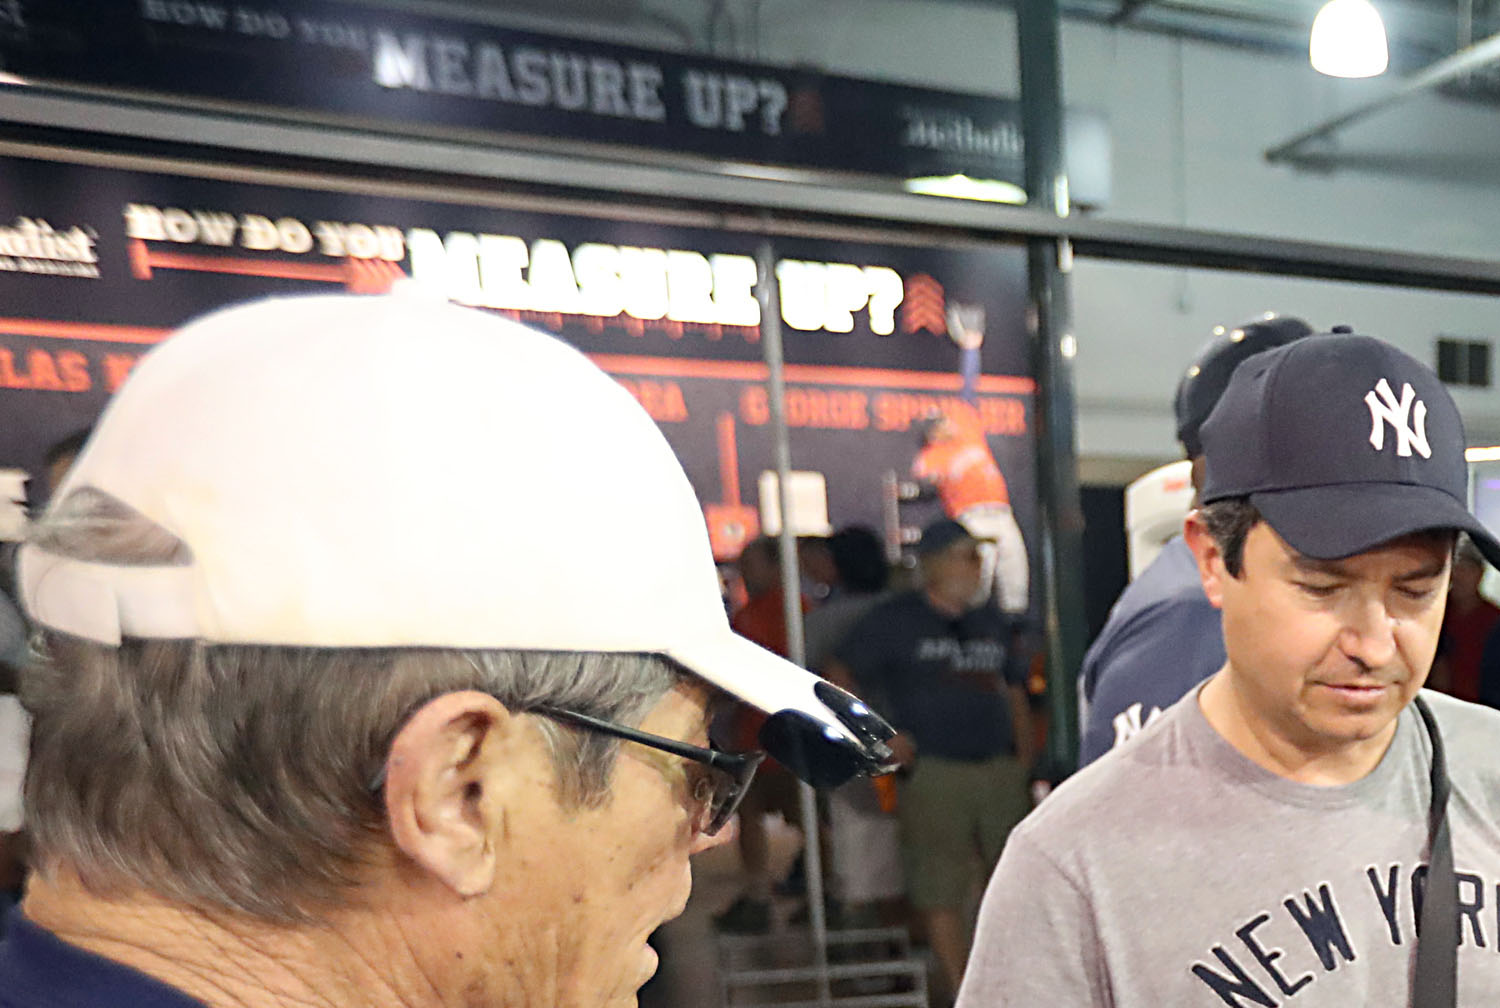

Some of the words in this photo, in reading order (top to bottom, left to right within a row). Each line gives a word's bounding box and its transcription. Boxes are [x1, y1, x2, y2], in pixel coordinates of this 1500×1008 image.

[373, 29, 667, 123] MEASURE
[682, 68, 788, 137] UP?
[124, 202, 236, 248] HOW
[241, 212, 313, 255] DO
[313, 218, 405, 262] YOU
[405, 227, 761, 328] MEASURE
[776, 258, 904, 336] UP?
[1364, 377, 1432, 460] NY
